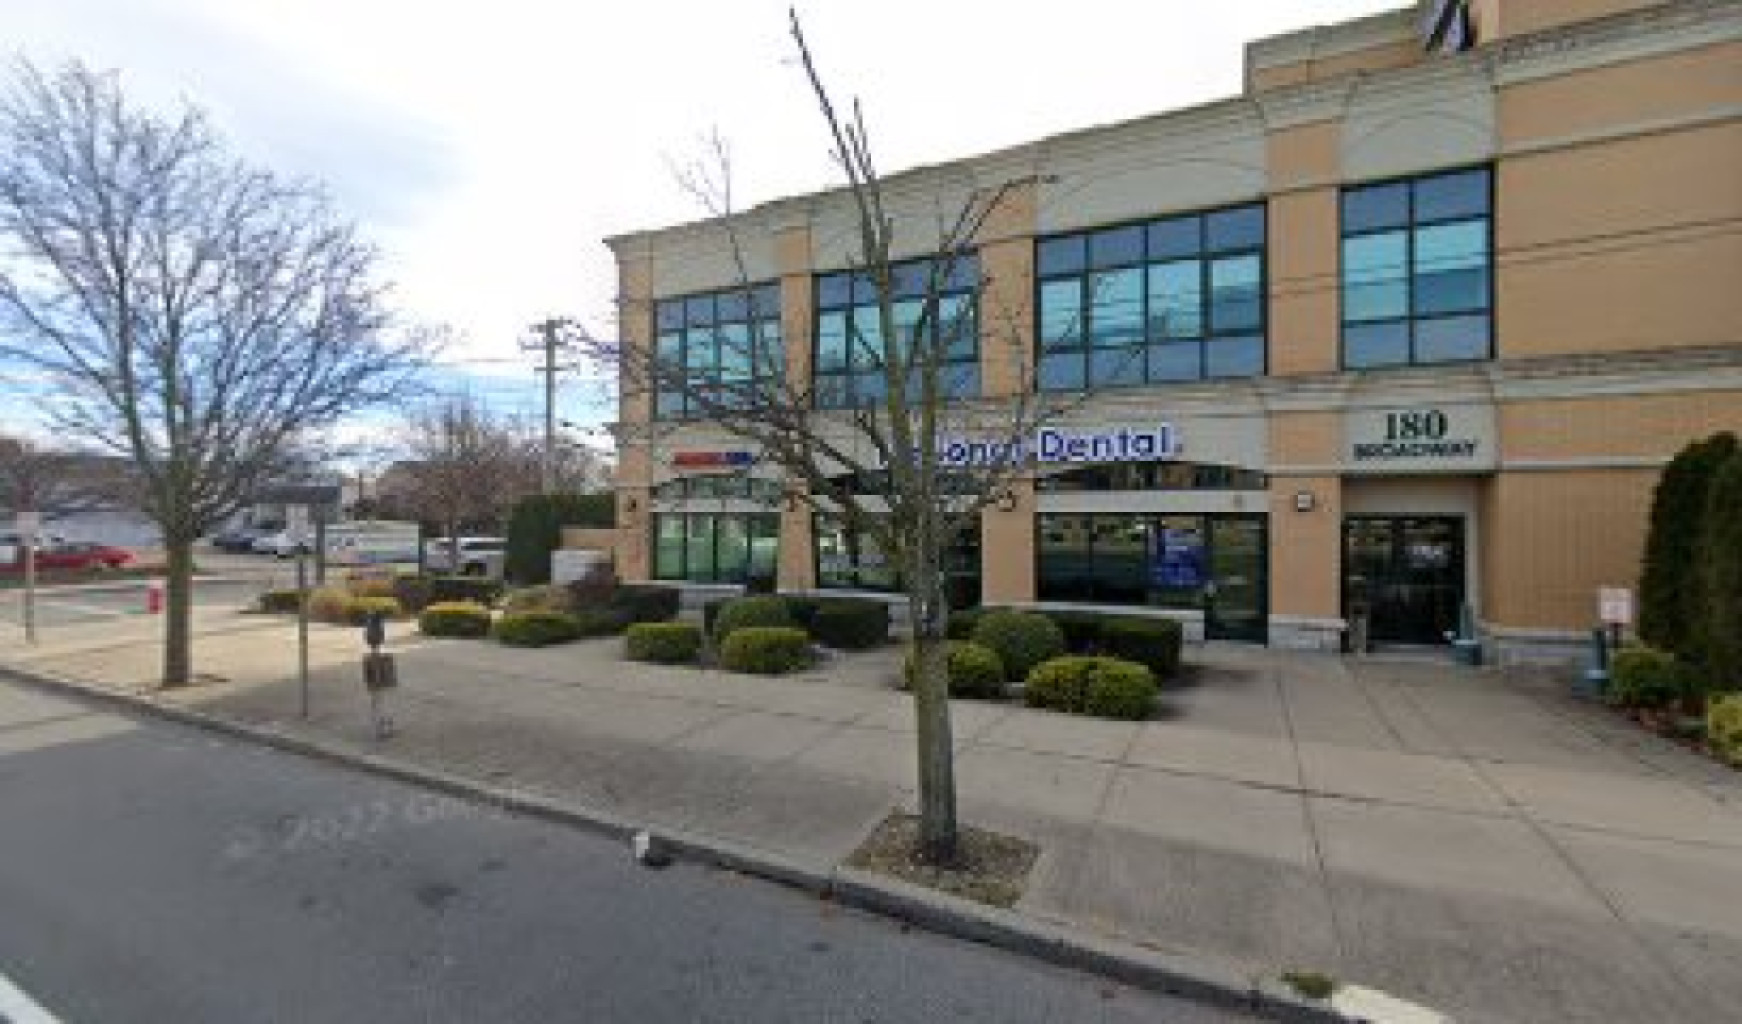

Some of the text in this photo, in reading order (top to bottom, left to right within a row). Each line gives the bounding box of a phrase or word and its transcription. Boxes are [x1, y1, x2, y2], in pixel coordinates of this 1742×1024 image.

[1386, 410, 1447, 439] 180
[1038, 424, 1172, 458] Dental
[1353, 441, 1477, 460] BROADWAY
